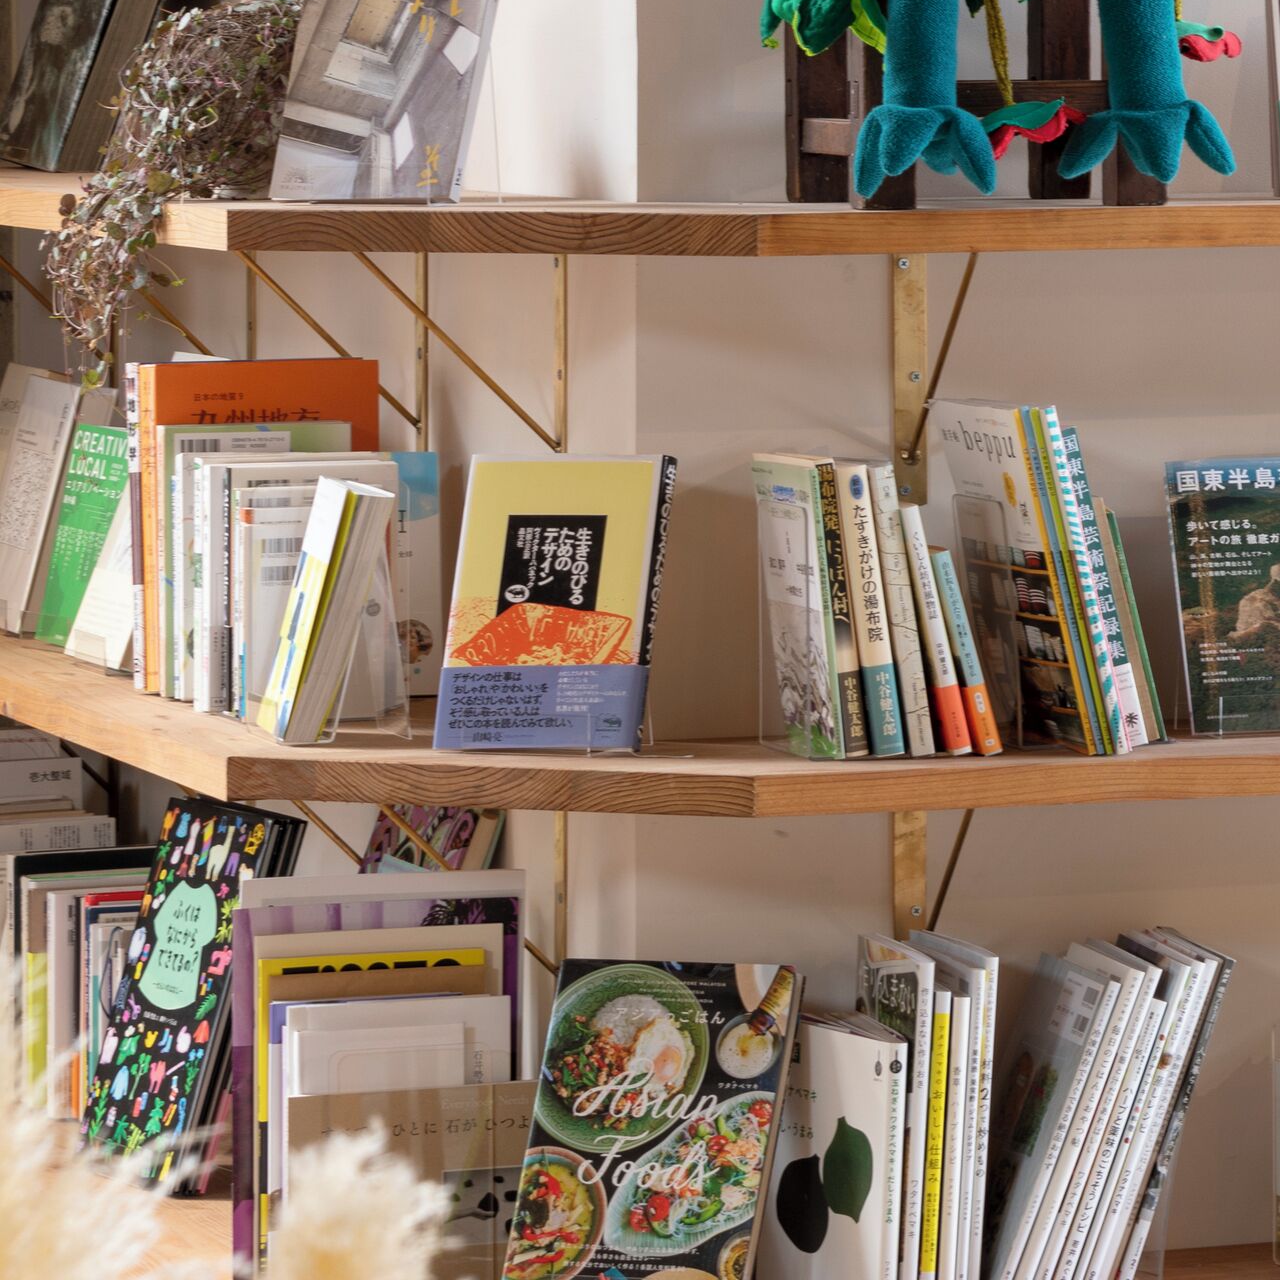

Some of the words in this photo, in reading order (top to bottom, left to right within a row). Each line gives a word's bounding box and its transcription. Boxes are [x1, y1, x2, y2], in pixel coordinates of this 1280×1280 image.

[958, 421, 1016, 463] beppu
[537, 527, 560, 586] デザイン
[554, 527, 575, 571] ための
[568, 527, 592, 605] 生きのびる
[1062, 435, 1125, 659] 国東半島芸術祭記録集
[1187, 534, 1242, 546] アートの旅
[852, 504, 884, 643] たすきがけの湯布院
[614, 1007, 727, 1025] アジアのごはん
[573, 1057, 729, 1122] Asian
[392, 1121, 437, 1137] ひとに
[577, 1130, 721, 1189] Foods
